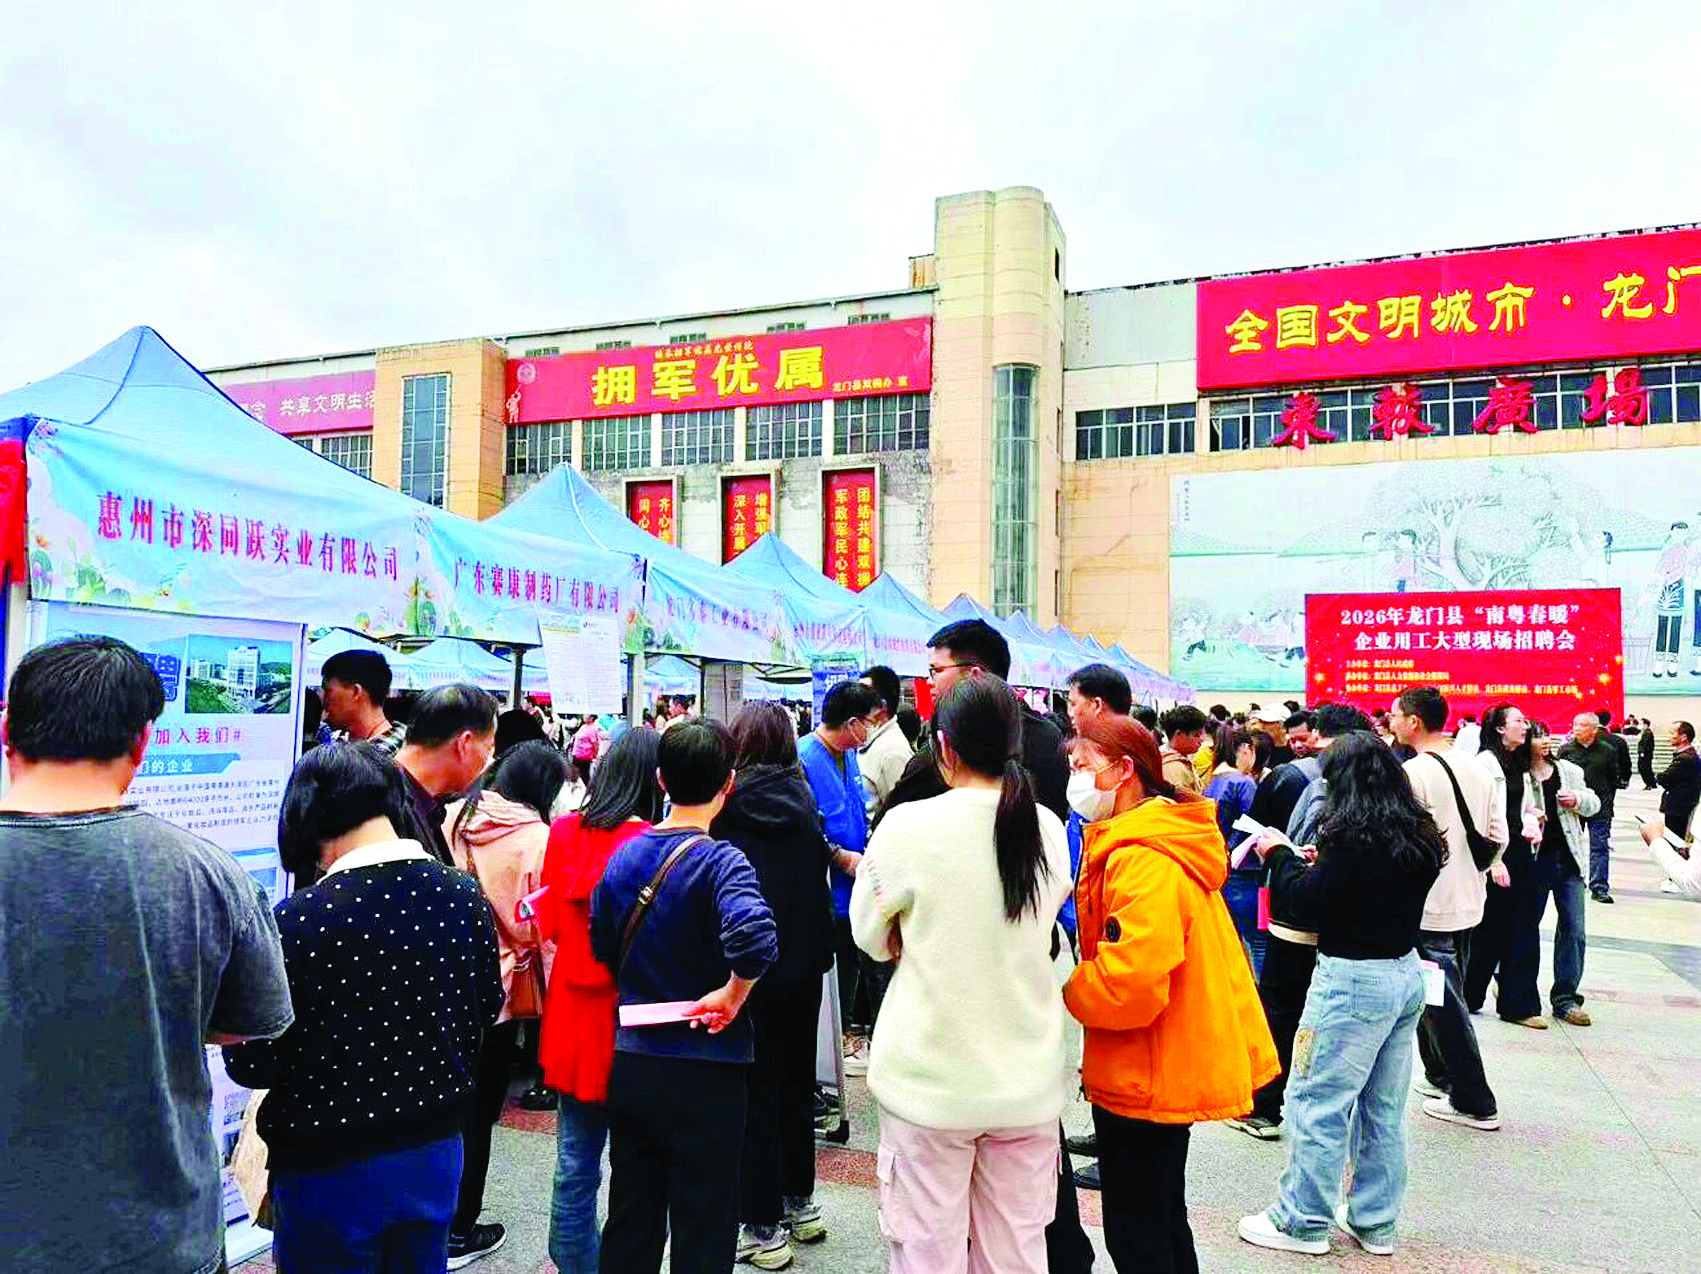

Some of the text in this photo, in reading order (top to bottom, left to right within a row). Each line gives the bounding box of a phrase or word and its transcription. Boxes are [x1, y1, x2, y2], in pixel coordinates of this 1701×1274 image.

[591, 346, 824, 405] 拥军优属
[98, 491, 398, 581] 惠州市深同跃实业有限公司
[733, 494, 746, 555] 深入开展
[1354, 630, 1576, 651] 企业用工大型现场招聘会
